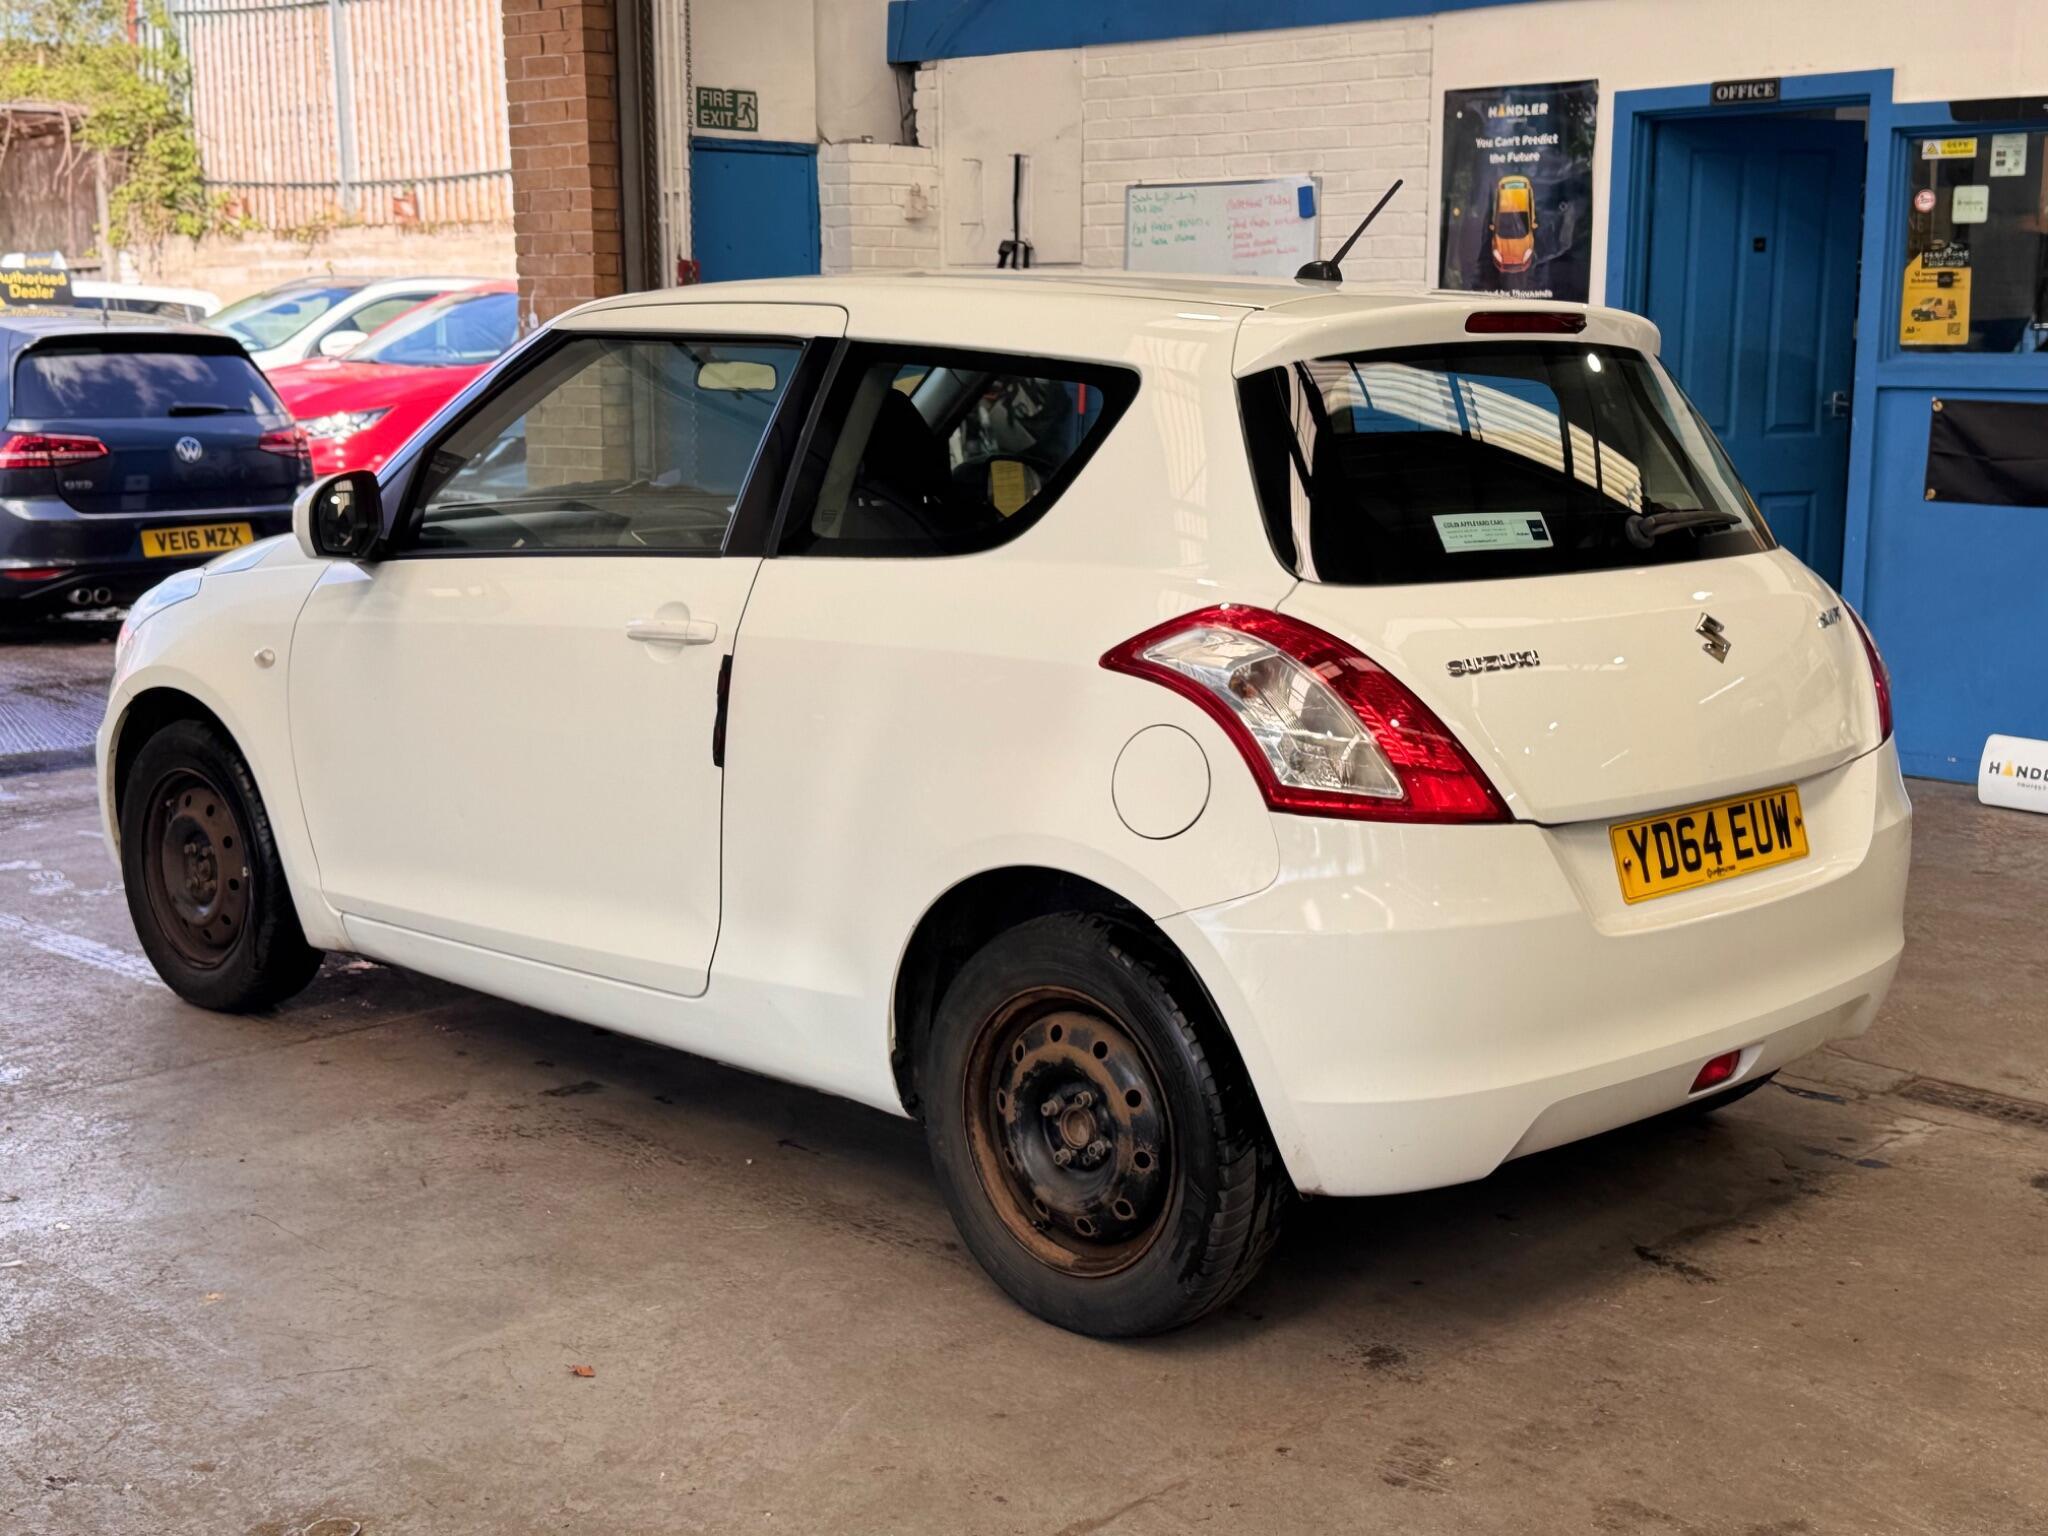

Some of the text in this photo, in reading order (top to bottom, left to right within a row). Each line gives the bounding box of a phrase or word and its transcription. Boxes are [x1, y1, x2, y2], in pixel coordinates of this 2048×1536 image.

[700, 90, 734, 108] FIRE
[1716, 82, 1776, 100] OFFICE
[700, 110, 734, 127] EXIT
[1488, 103, 1548, 118] HANDLER
[1476, 133, 1559, 148] You Can't Predict
[1490, 152, 1540, 164] the Future
[9, 284, 55, 298] Dealer
[155, 527, 244, 551] VE16 MZX
[1447, 650, 1540, 677] SUZUKI
[1627, 794, 1793, 884] YD64 EUW
